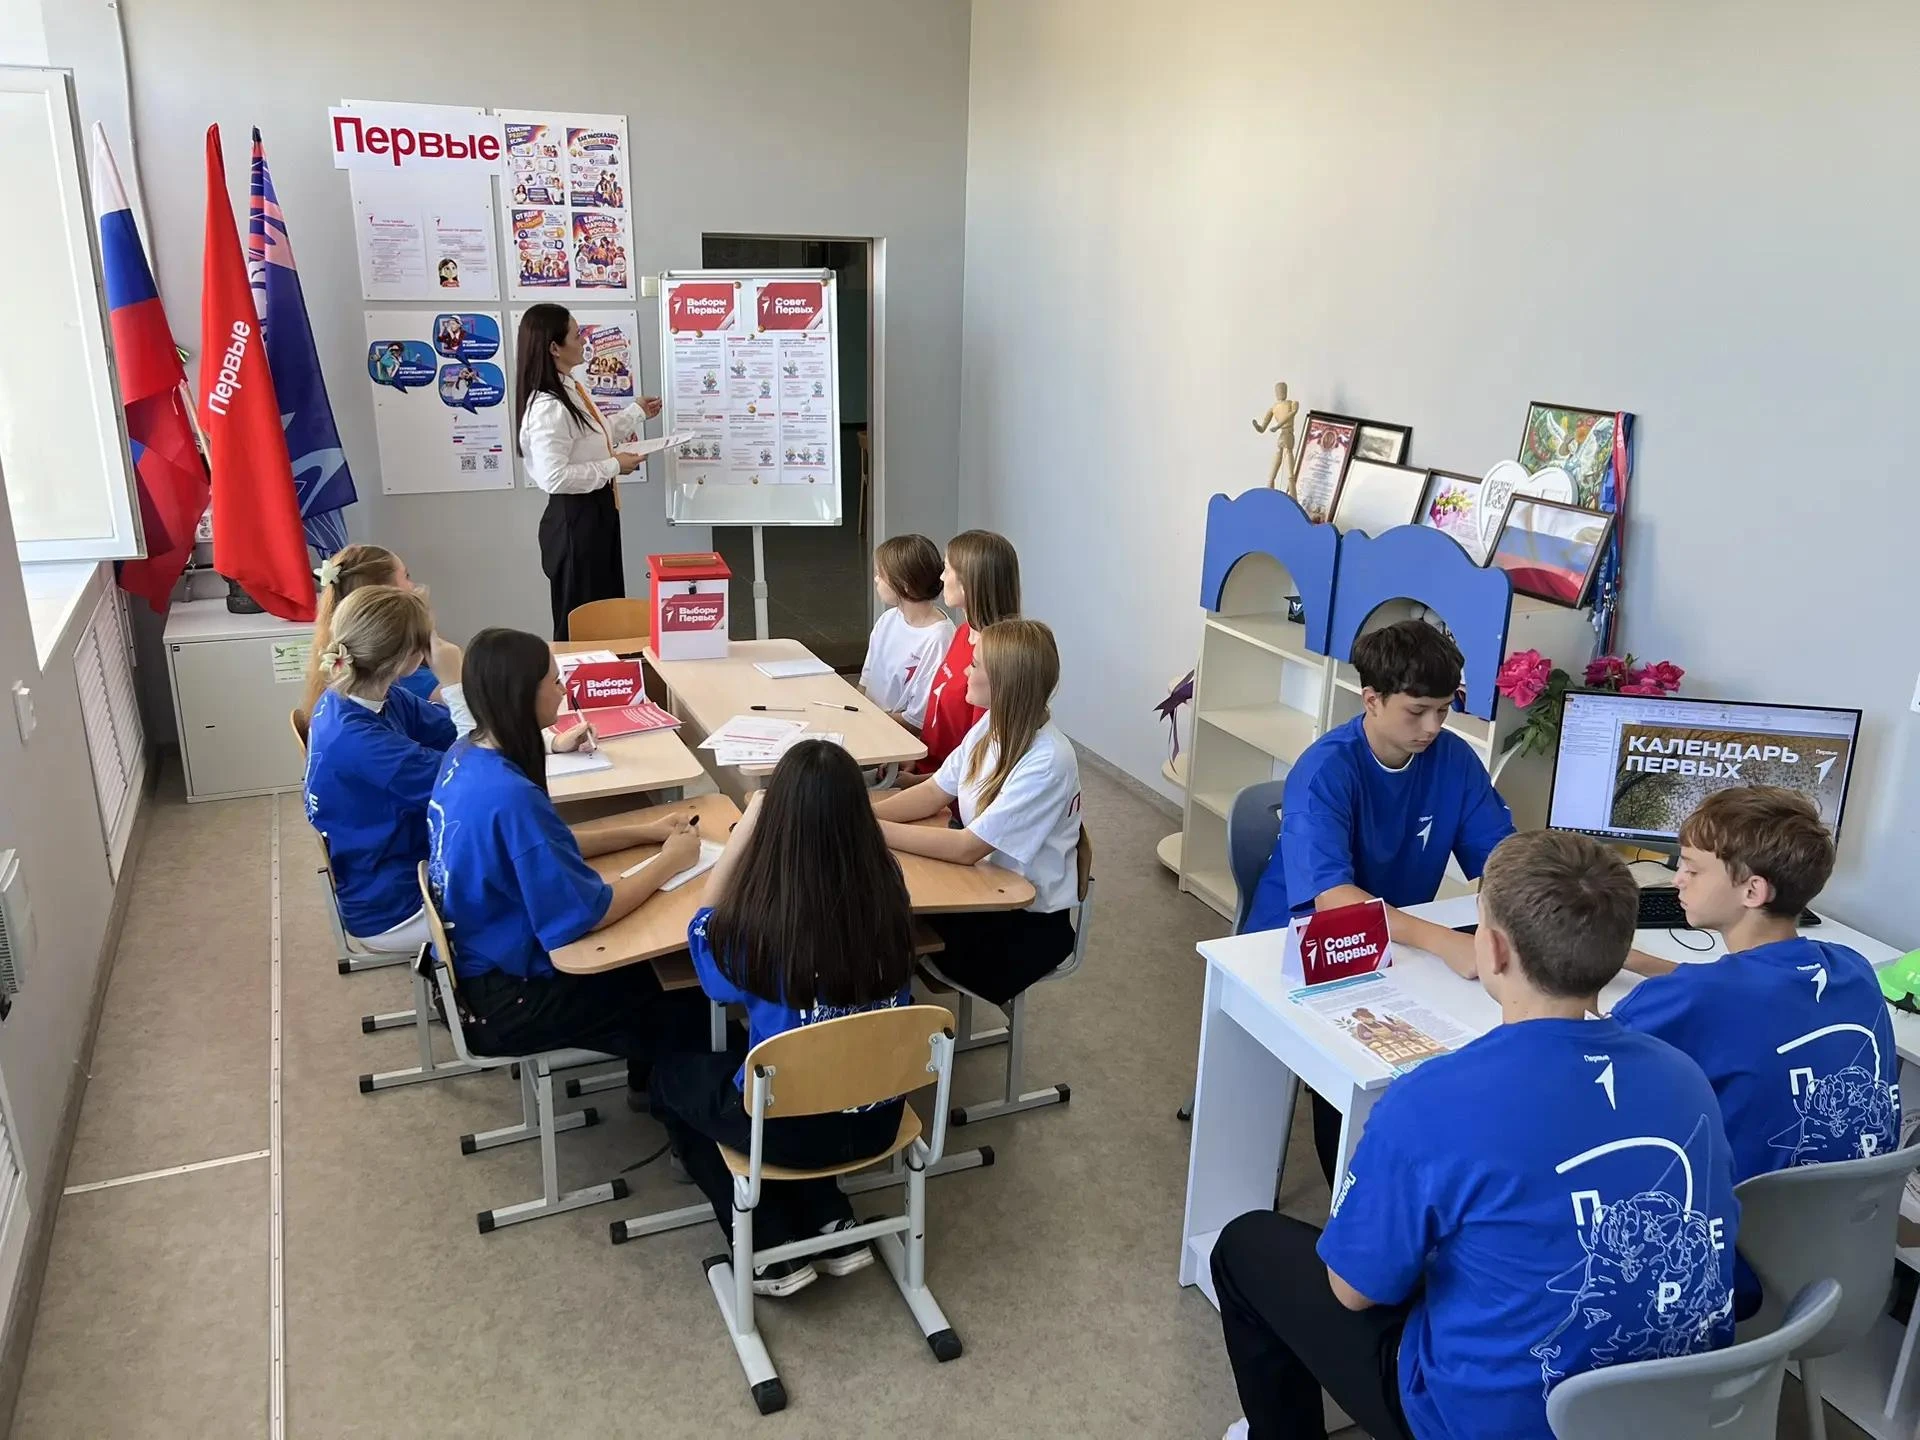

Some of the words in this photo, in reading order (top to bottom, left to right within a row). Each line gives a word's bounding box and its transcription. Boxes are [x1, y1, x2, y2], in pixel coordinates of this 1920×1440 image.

[333, 116, 500, 166] Первые
[687, 298, 727, 307] Выборы
[775, 297, 807, 306] Совет
[687, 306, 725, 315] Первых
[775, 305, 814, 314] Первых
[208, 320, 250, 415] Первые
[679, 606, 718, 615] Выборы
[679, 614, 716, 623] Первых
[586, 678, 634, 689] Выборы
[587, 686, 633, 698] Первых
[1628, 735, 1799, 764] КАЛЕНДАРЬ
[1626, 755, 1743, 779] ПЕРВЫХ
[1324, 932, 1366, 951] Совет
[1326, 943, 1378, 965] Первых
